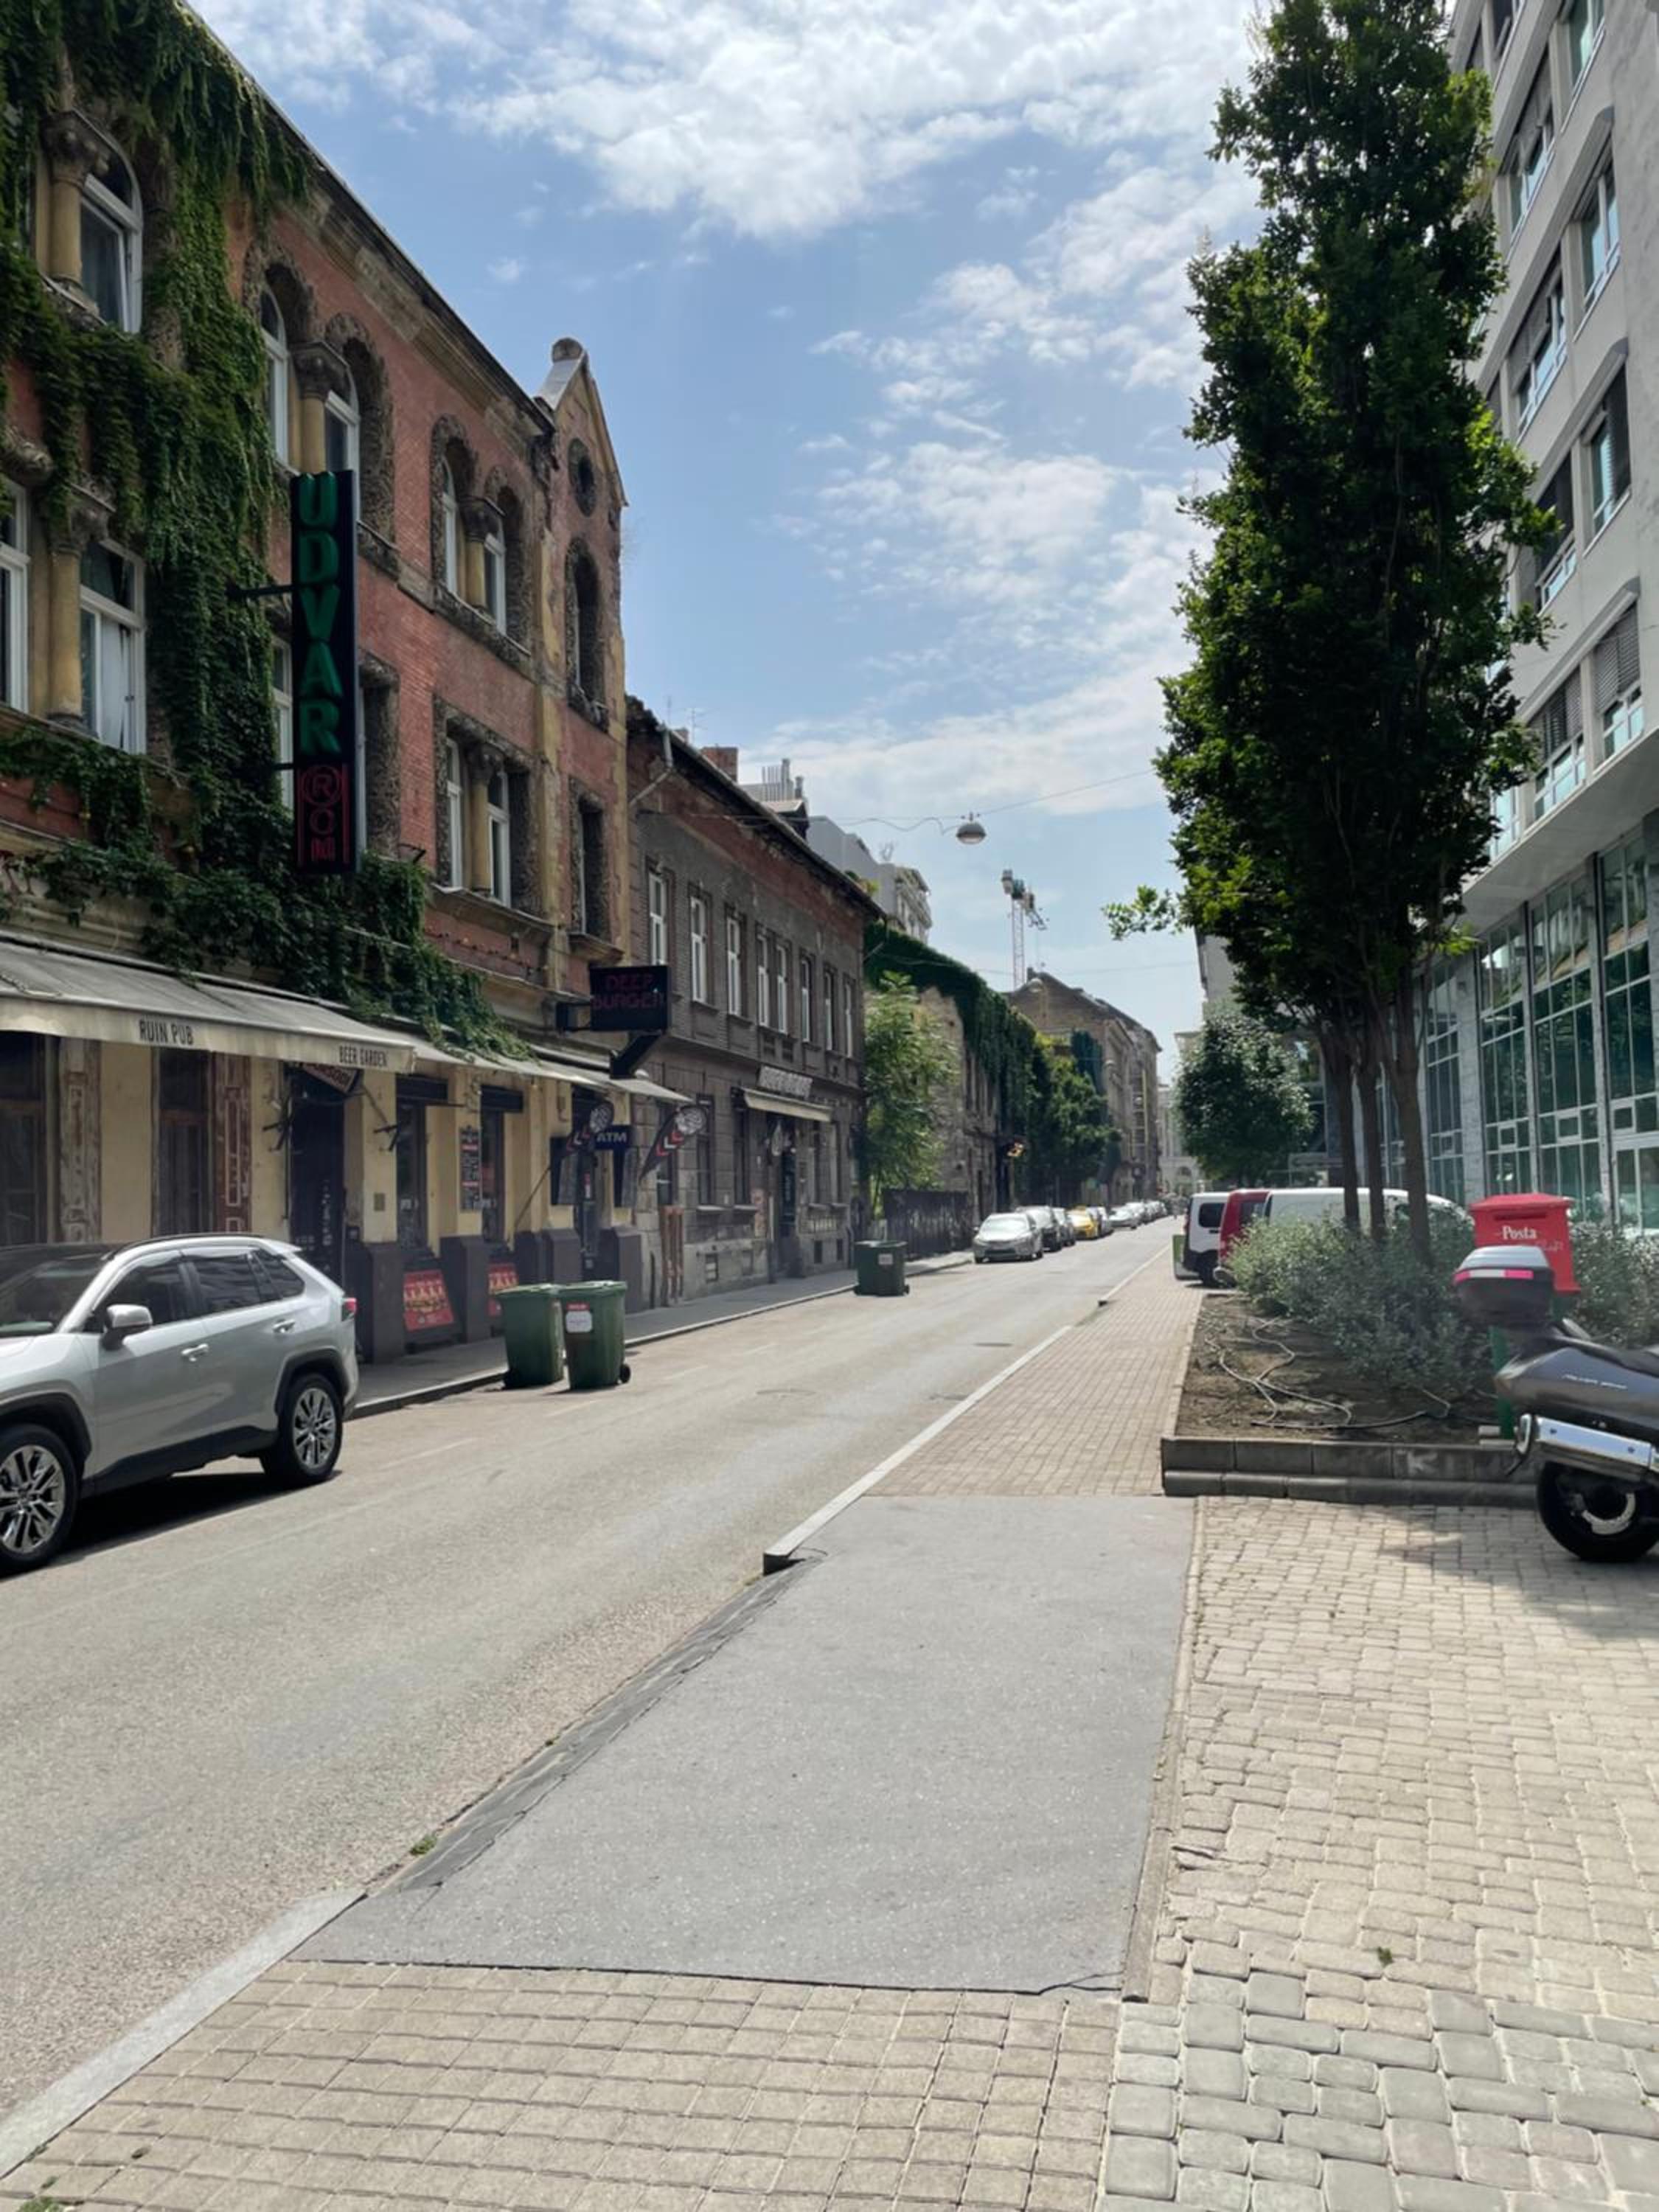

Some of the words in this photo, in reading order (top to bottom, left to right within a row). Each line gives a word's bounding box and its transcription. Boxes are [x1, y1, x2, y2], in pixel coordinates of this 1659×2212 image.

[298, 471, 343, 755] UDVAR
[605, 973, 654, 990] DEEP
[139, 1020, 168, 1043] RUIN
[172, 1023, 194, 1046] PUB
[339, 1046, 357, 1064] BEER
[359, 1048, 388, 1067] GARDEN
[596, 1132, 627, 1143] ATM
[1502, 1225, 1537, 1240] Posta
